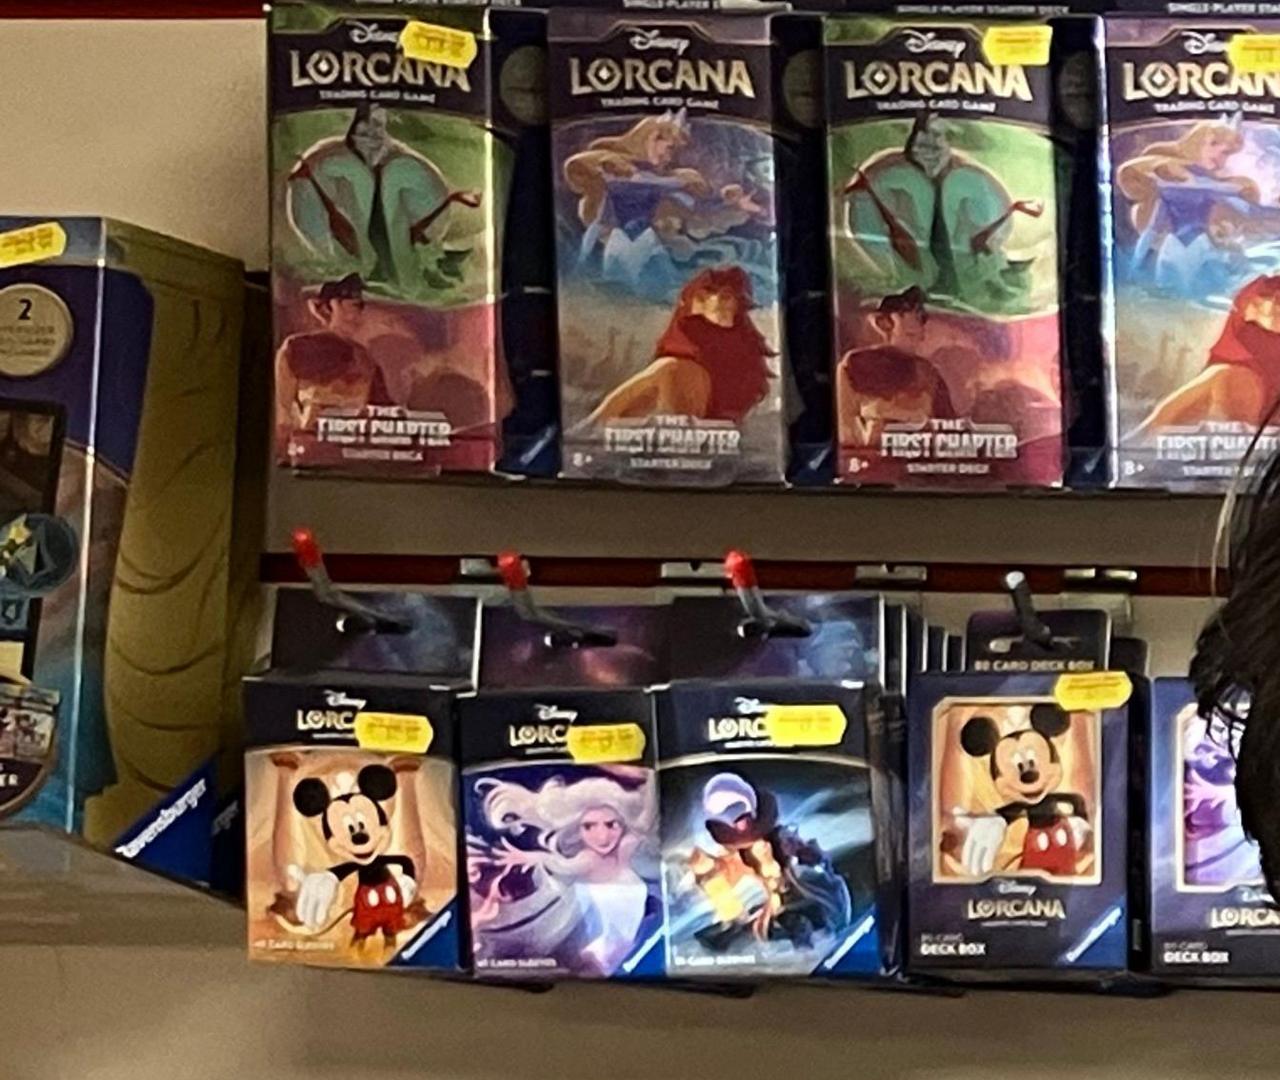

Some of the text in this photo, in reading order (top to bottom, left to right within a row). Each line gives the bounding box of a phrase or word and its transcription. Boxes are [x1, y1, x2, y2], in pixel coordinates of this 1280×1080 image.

[622, 27, 690, 55] Disney
[902, 29, 966, 58] Disney
[290, 51, 471, 92] LORCANA
[569, 57, 755, 98] LORCANA
[844, 60, 1032, 101] LORCANA
[1154, 101, 1275, 113] TRADING CARD GAME
[18, 299, 32, 320] 2
[933, 419, 963, 431] THE
[992, 660, 1028, 671] CARD
[1031, 661, 1065, 671] DECK
[324, 690, 366, 711] Disney
[536, 703, 577, 723] Disney
[999, 882, 1036, 897] Disney
[967, 898, 1066, 920] LORCANA
[920, 944, 987, 956] DECK BOX
[1164, 951, 1229, 963] DECK BOX
